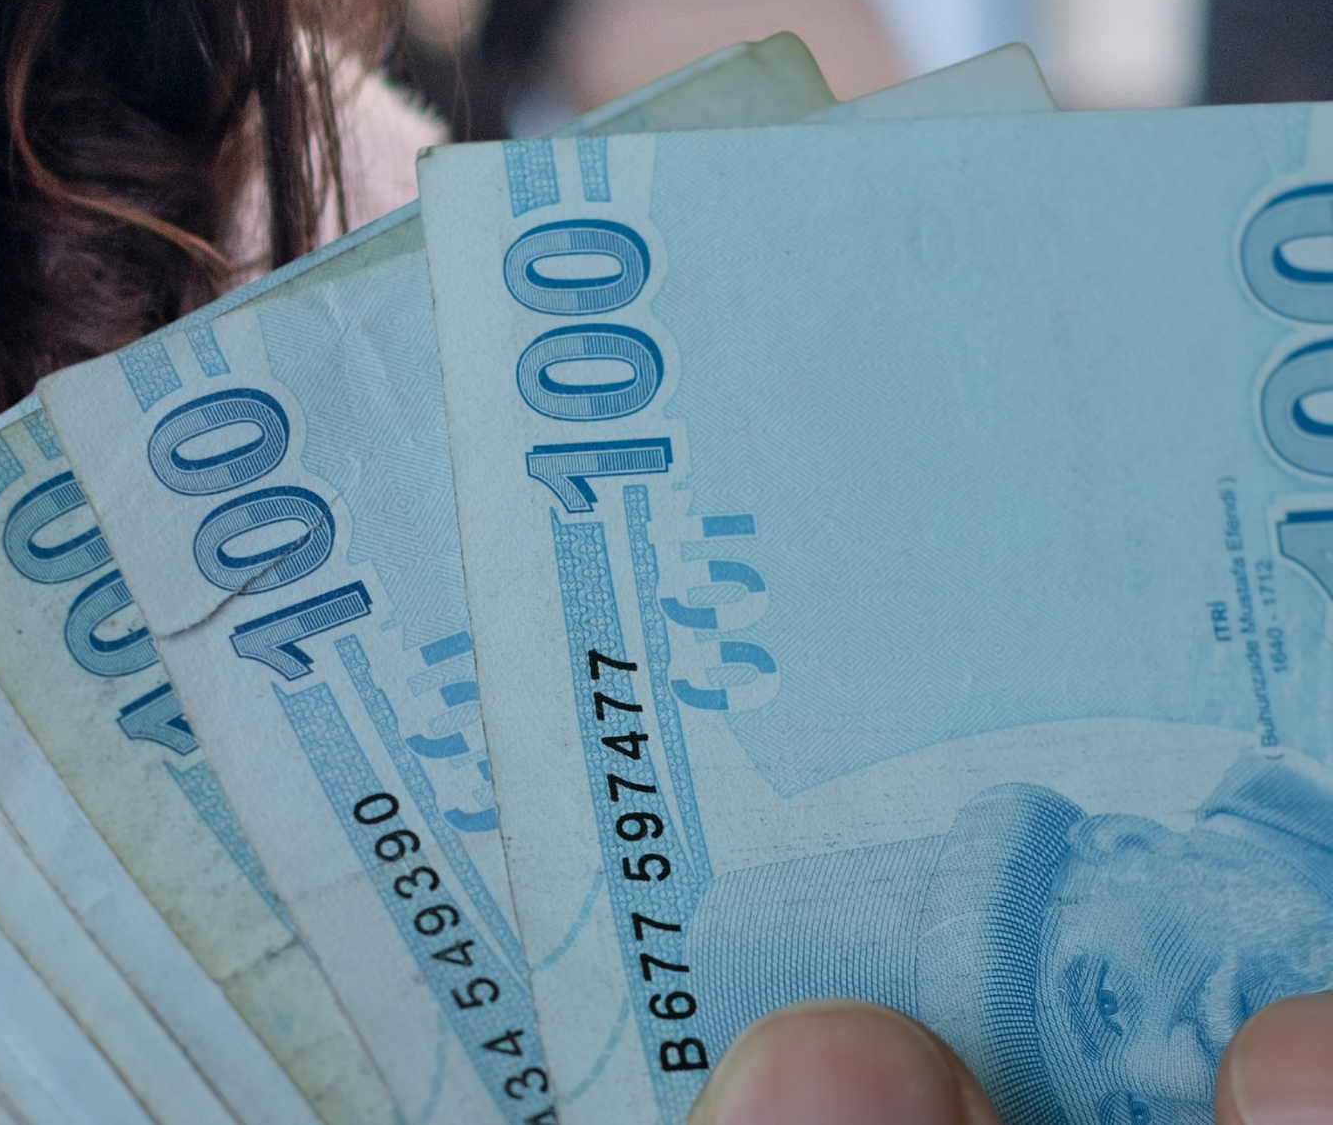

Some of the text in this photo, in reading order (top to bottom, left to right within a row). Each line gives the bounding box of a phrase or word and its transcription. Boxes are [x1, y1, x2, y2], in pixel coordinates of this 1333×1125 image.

[502, 217, 674, 514] 100
[146, 387, 373, 682] 100
[1228, 557, 1257, 635] Mustafa
[1255, 559, 1278, 607] 1712
[1265, 626, 1289, 675] 1640
[353, 792, 501, 1010] 549390
[588, 648, 710, 1073] B677 597477
